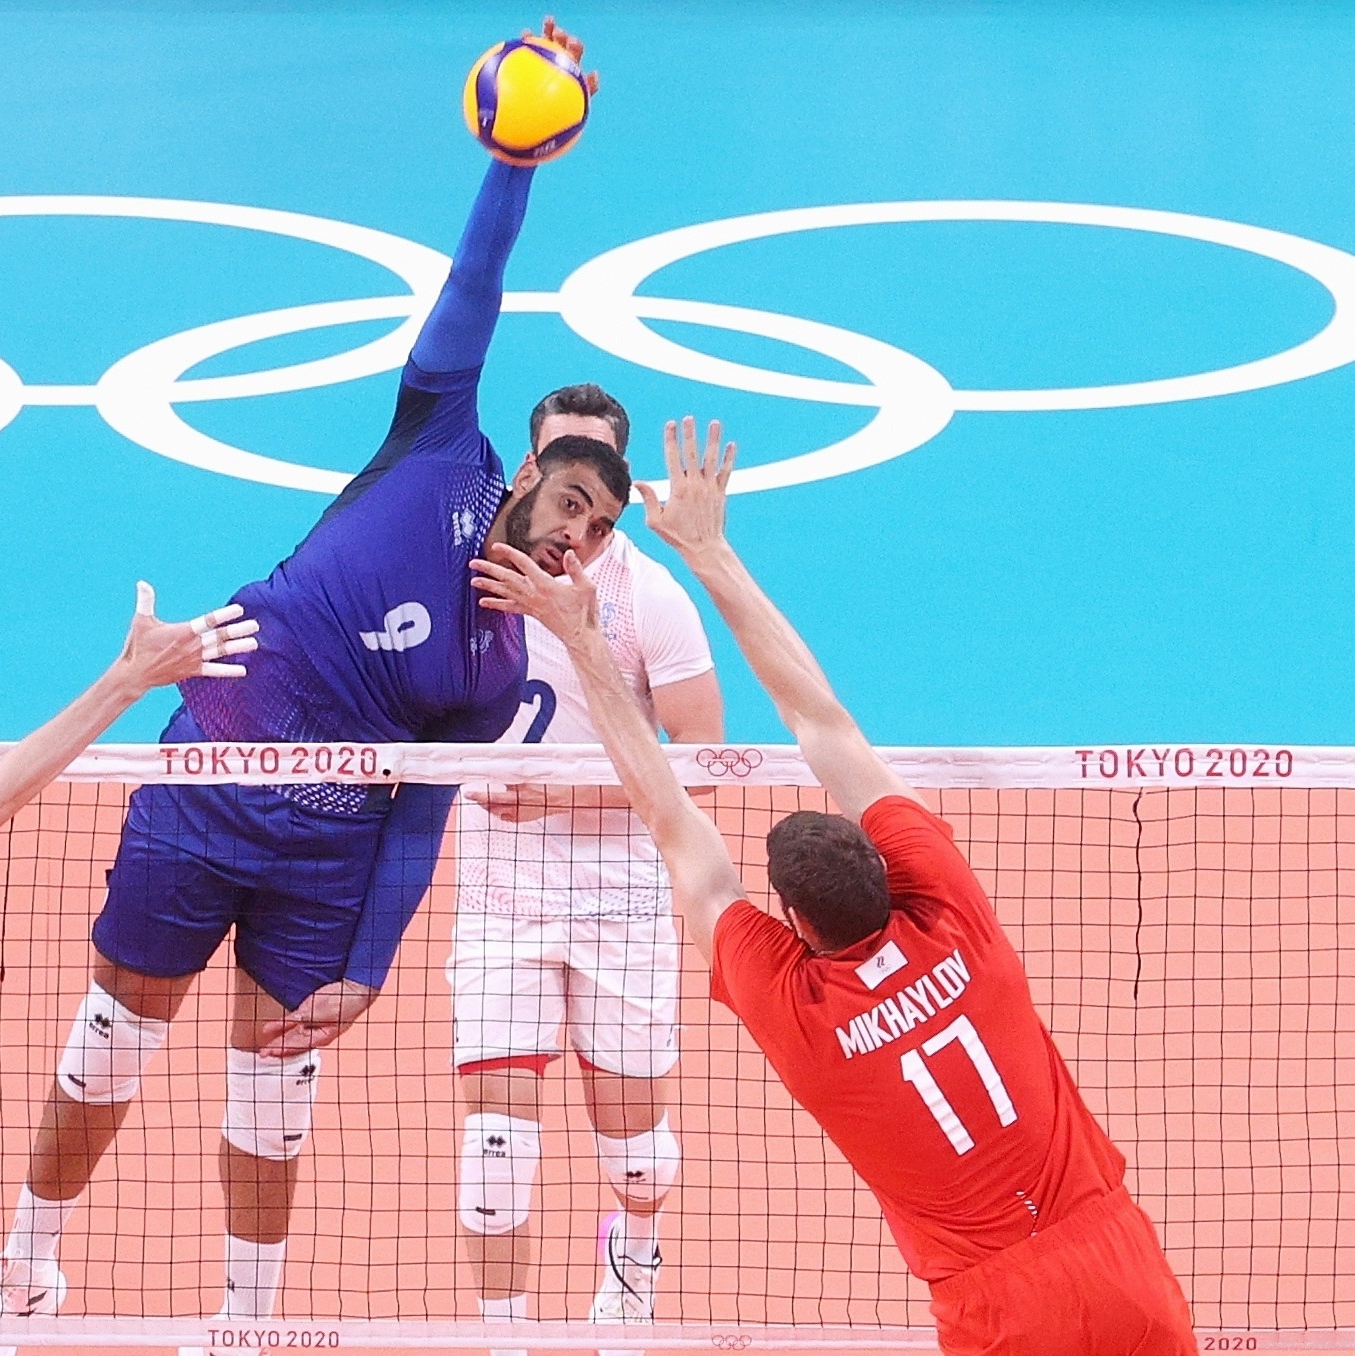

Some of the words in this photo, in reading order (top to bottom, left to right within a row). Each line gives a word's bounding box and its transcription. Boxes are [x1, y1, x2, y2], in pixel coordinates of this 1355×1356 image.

[359, 601, 432, 653] 9
[159, 746, 280, 775] TOKYO
[290, 746, 378, 777] 2020
[1074, 748, 1195, 779] TOKYO
[1205, 748, 1294, 778] 2020
[835, 948, 972, 1060] MIKHAYLOV
[900, 1013, 1019, 1157] 17
[207, 1329, 280, 1348] TOKYO
[286, 1330, 340, 1348] 2020
[1203, 1336, 1257, 1351] 2020
